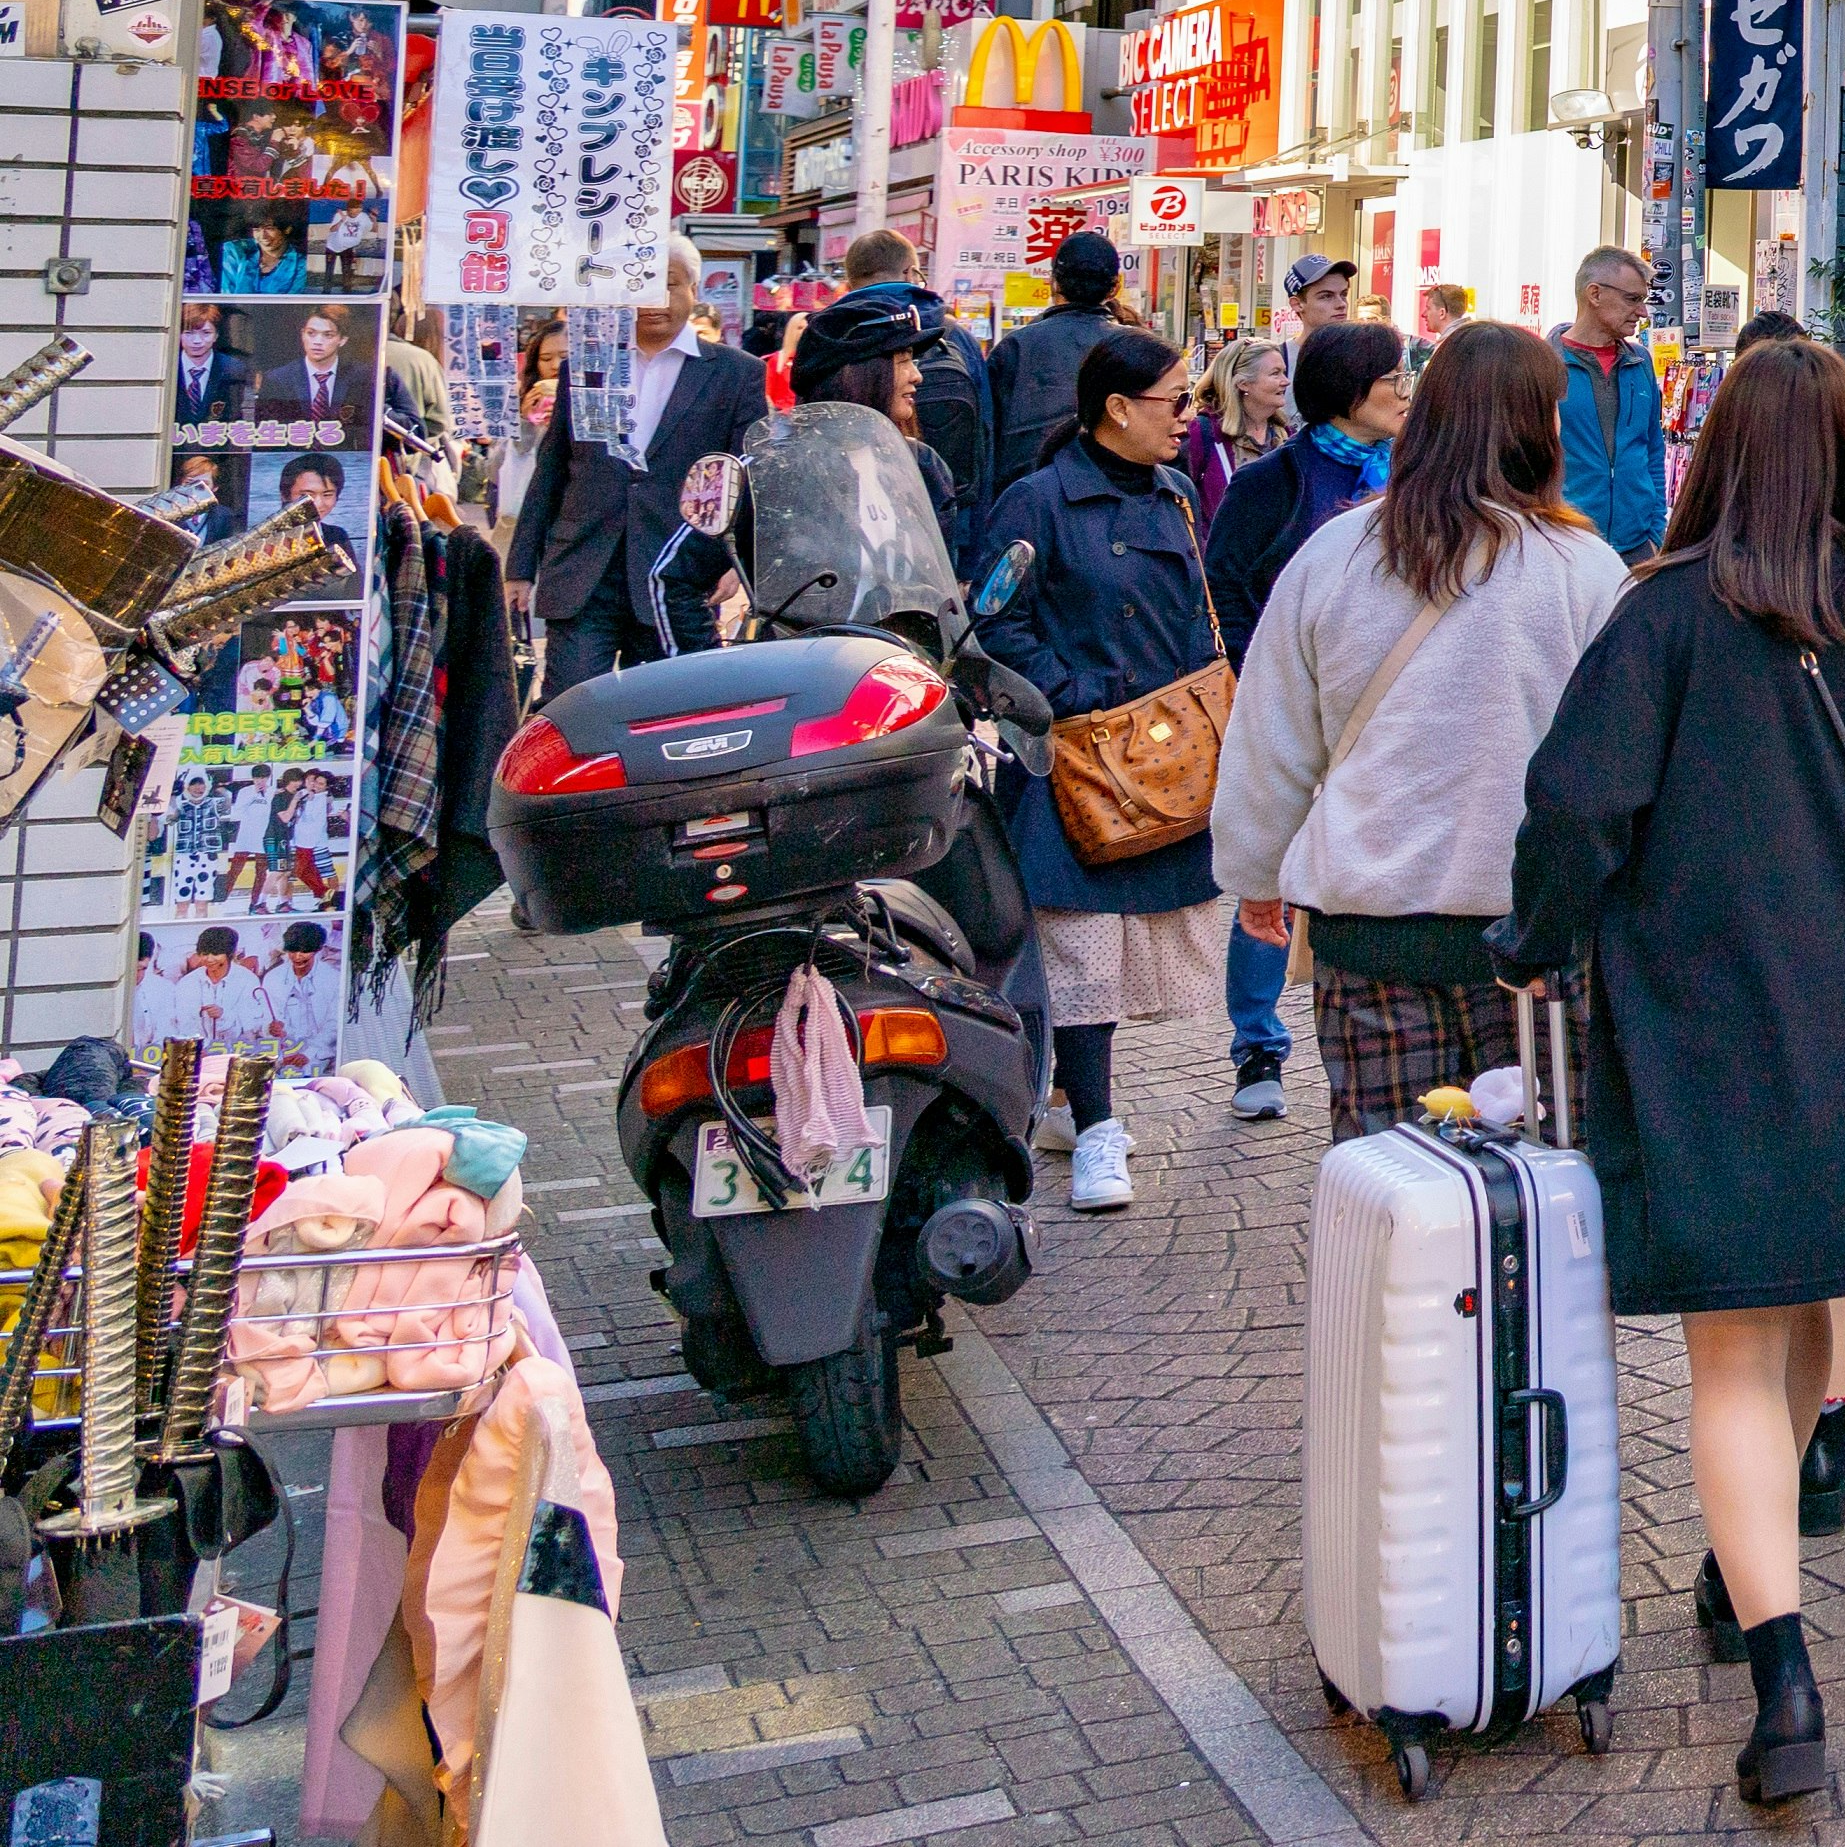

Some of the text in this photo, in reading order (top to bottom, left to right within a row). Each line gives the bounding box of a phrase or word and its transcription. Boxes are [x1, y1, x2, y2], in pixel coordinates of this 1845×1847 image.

[1119, 6, 1223, 87] BIC CAMERA
[267, 82, 293, 101] or
[302, 80, 375, 102] LOVE
[1129, 75, 1199, 138] SELECT
[959, 139, 1145, 164] Accessory shop ¥300
[958, 163, 1054, 187] PARIS
[1251, 191, 1311, 238] DAISO
[994, 225, 1018, 237] 土曜
[1139, 222, 1196, 233] ビックカメラ
[1148, 232, 1186, 240] SELECT
[460, 210, 510, 294] 可能
[1519, 283, 1541, 315] 原宿
[1704, 290, 1739, 310] 足袋靴下
[173, 419, 344, 449] いまを生きる
